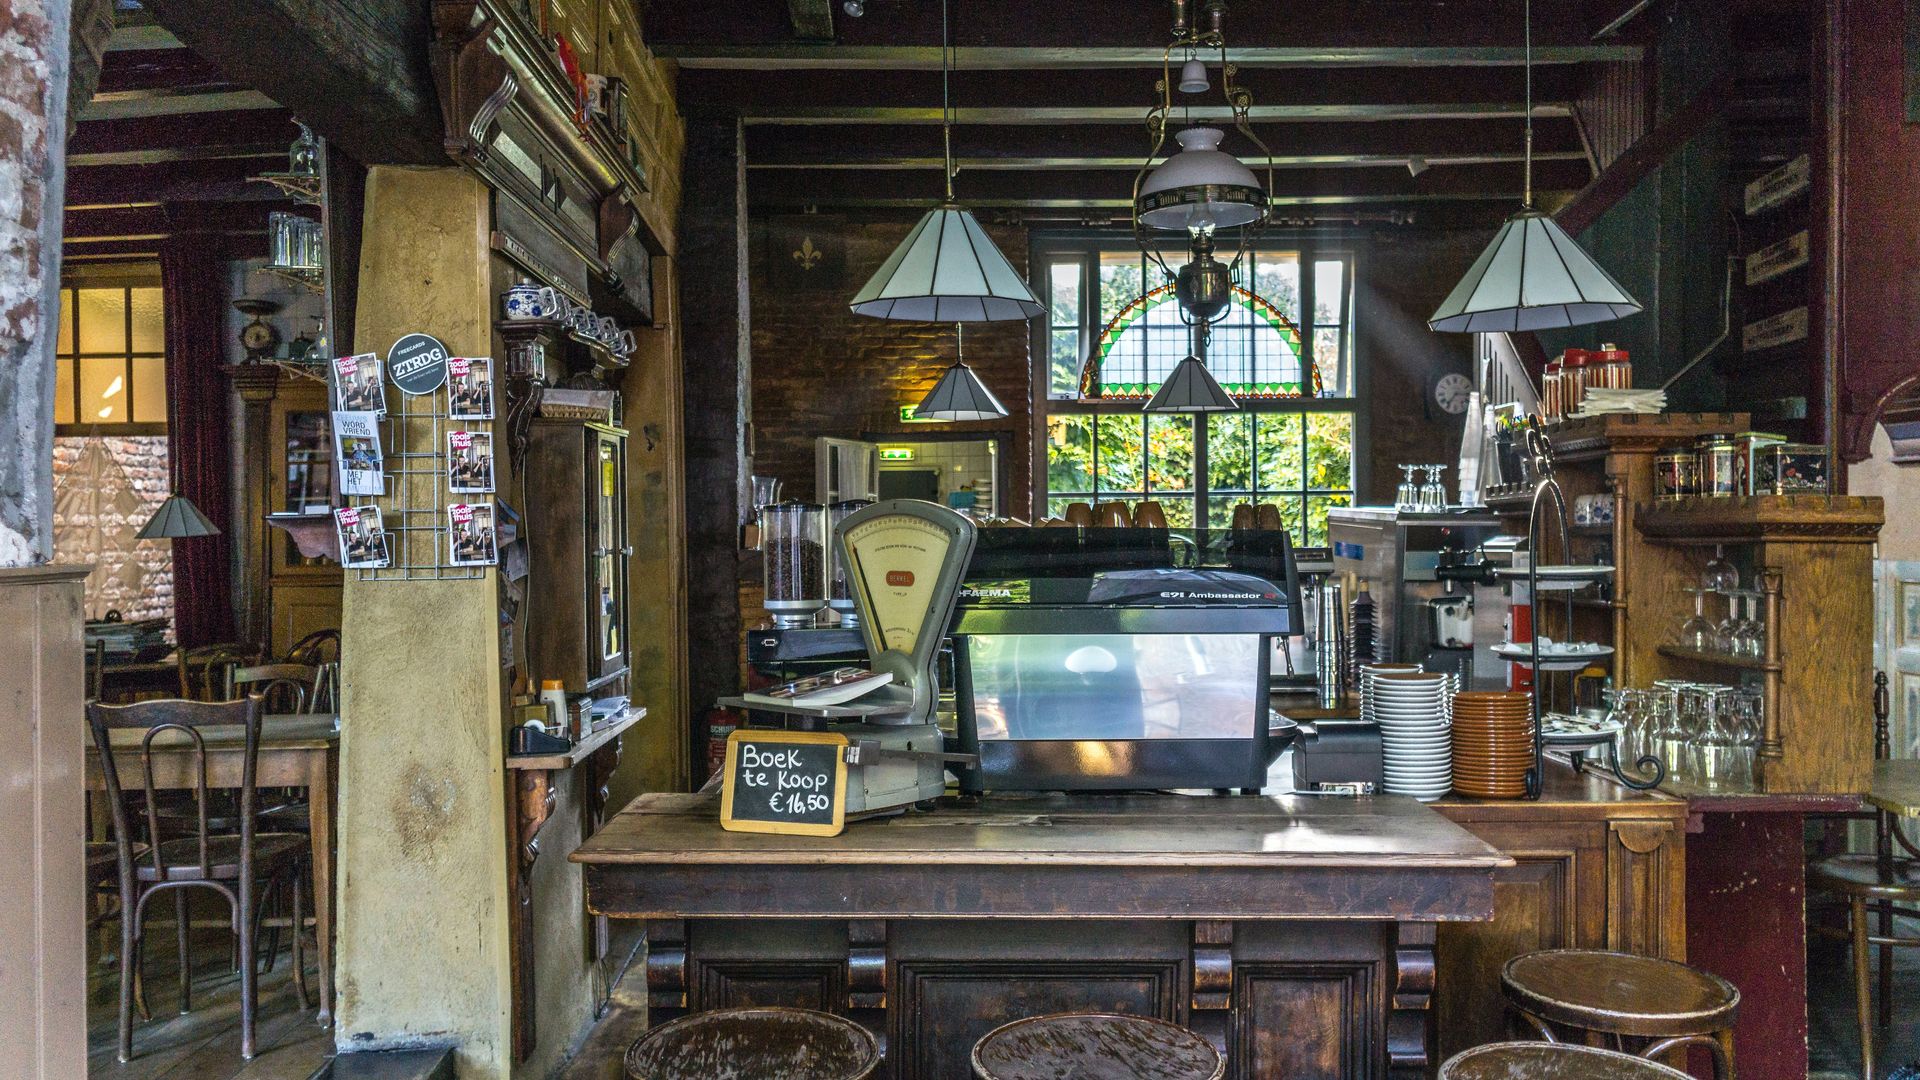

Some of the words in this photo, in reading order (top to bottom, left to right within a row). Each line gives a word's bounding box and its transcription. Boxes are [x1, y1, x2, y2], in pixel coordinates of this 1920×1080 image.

[397, 341, 426, 356] FREECARDS
[393, 348, 443, 377] ZTRDG
[338, 364, 358, 374] thuis
[450, 366, 470, 374] thuis
[342, 421, 366, 429] WORD
[343, 428, 371, 436] VRIEND
[451, 440, 472, 448] thuis
[347, 471, 363, 479] MET
[452, 506, 471, 514] zoals
[959, 589, 1011, 597] FAEMA
[743, 769, 769, 787] te
